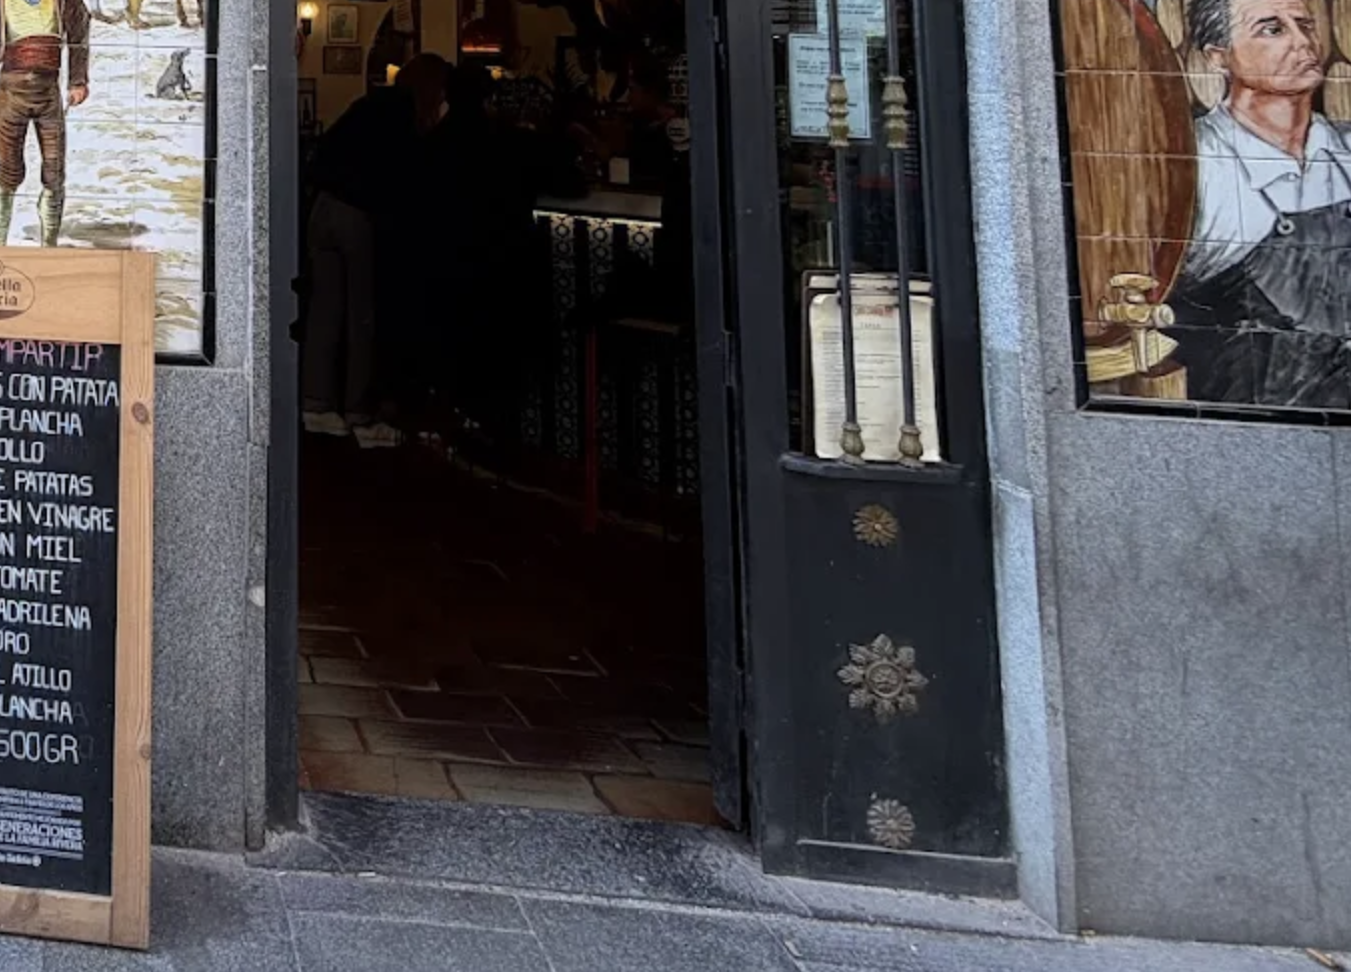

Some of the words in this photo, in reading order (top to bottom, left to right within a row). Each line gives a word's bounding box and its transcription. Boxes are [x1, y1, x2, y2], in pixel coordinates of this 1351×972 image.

[9, 373, 45, 402] CON
[50, 377, 120, 407] PATATA
[14, 470, 94, 497] PATATAS
[26, 501, 114, 532] VINAGRE
[26, 535, 81, 563] MIEL
[11, 665, 72, 693] AJILLO
